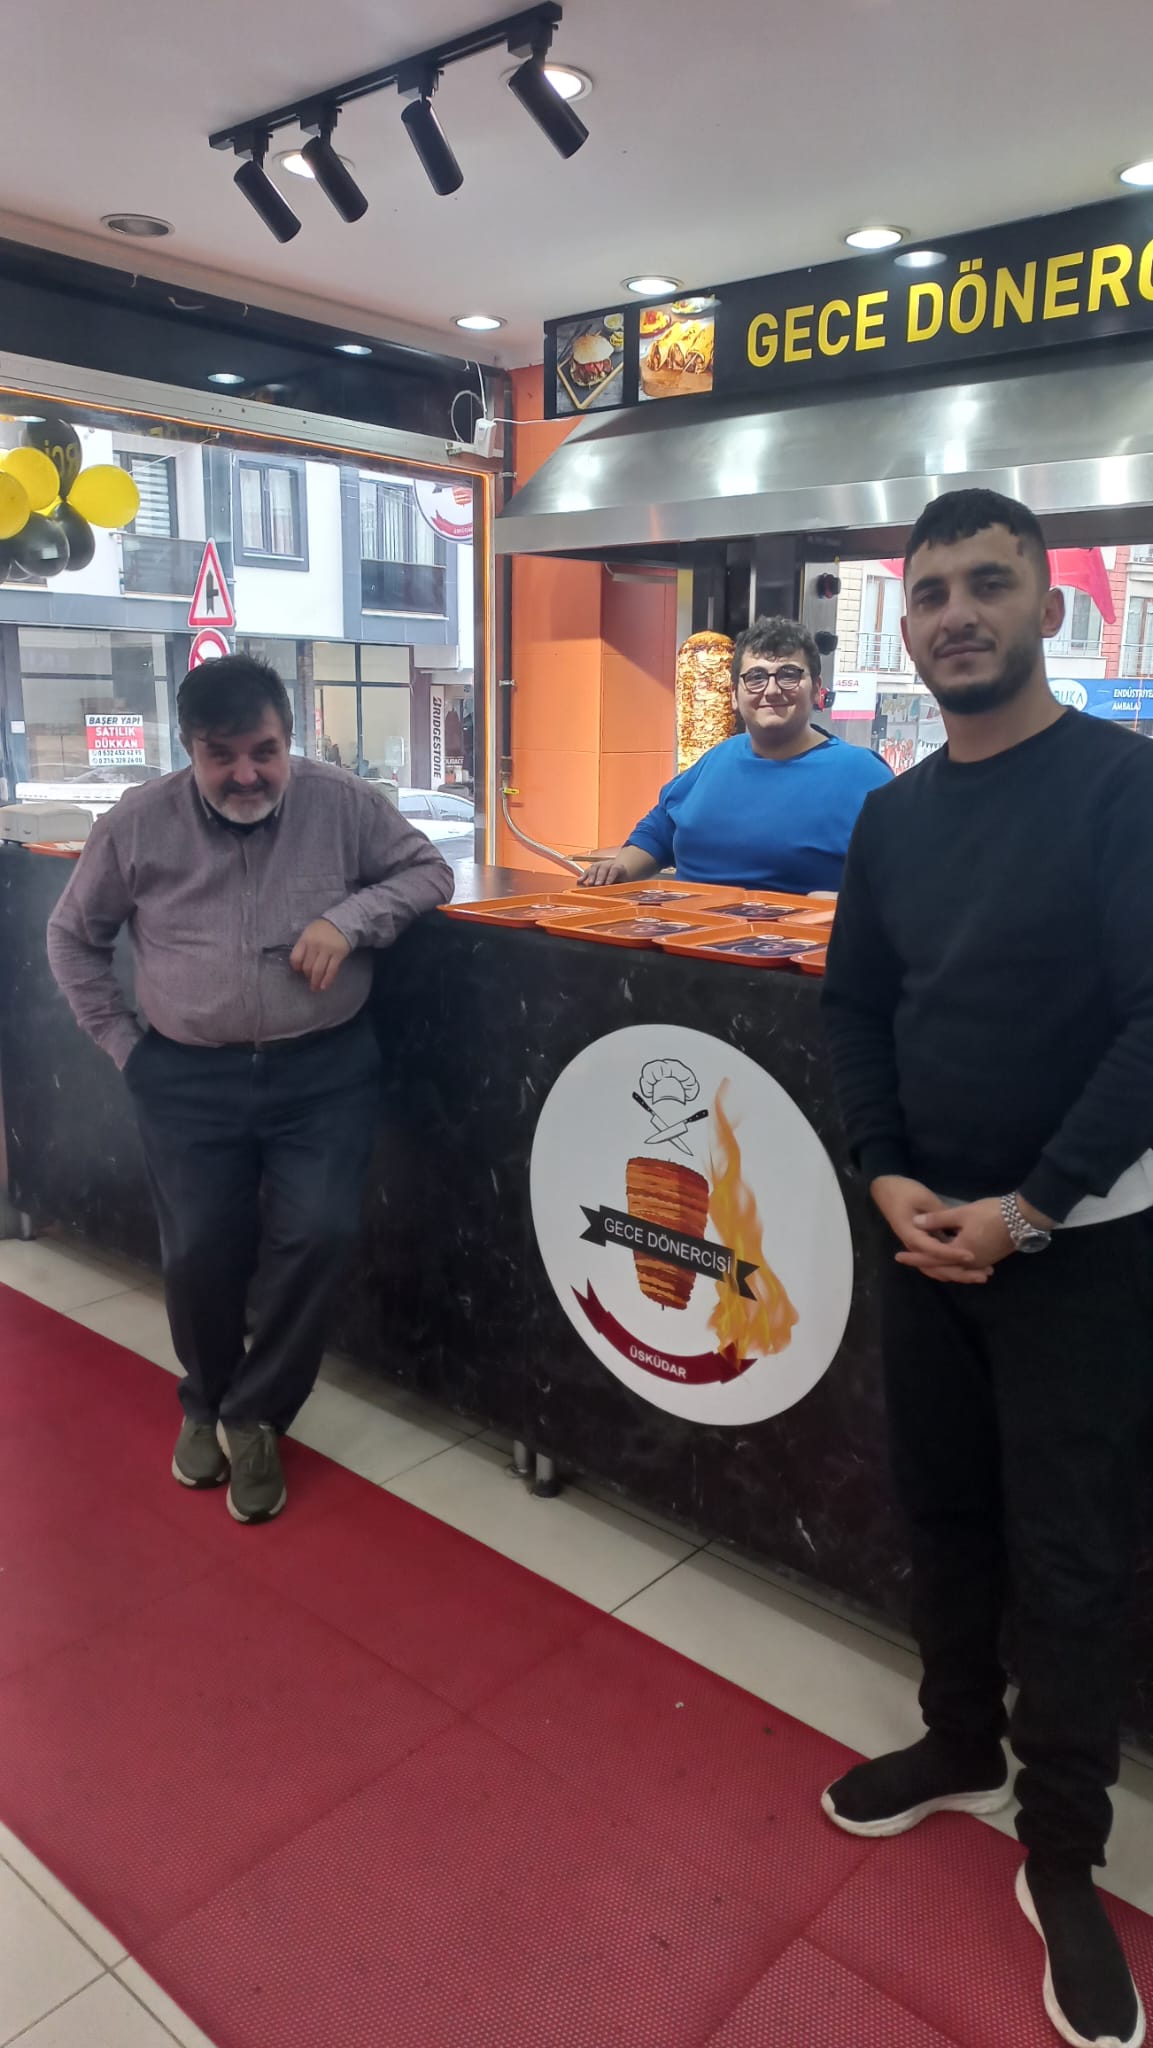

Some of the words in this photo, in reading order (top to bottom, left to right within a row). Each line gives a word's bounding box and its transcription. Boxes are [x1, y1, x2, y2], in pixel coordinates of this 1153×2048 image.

[746, 289, 889, 368] GECE
[835, 679, 859, 687] ASSA
[89, 716, 118, 726] BAŞER
[95, 726, 136, 737] SATILIK
[94, 737, 139, 749] DÜKKAN
[432, 695, 442, 780] BRIDGESTONE
[603, 1216, 644, 1244] GECE
[646, 1230, 732, 1275] DÖNERCİSİ
[628, 1344, 687, 1380] ÜSKÜDAR
